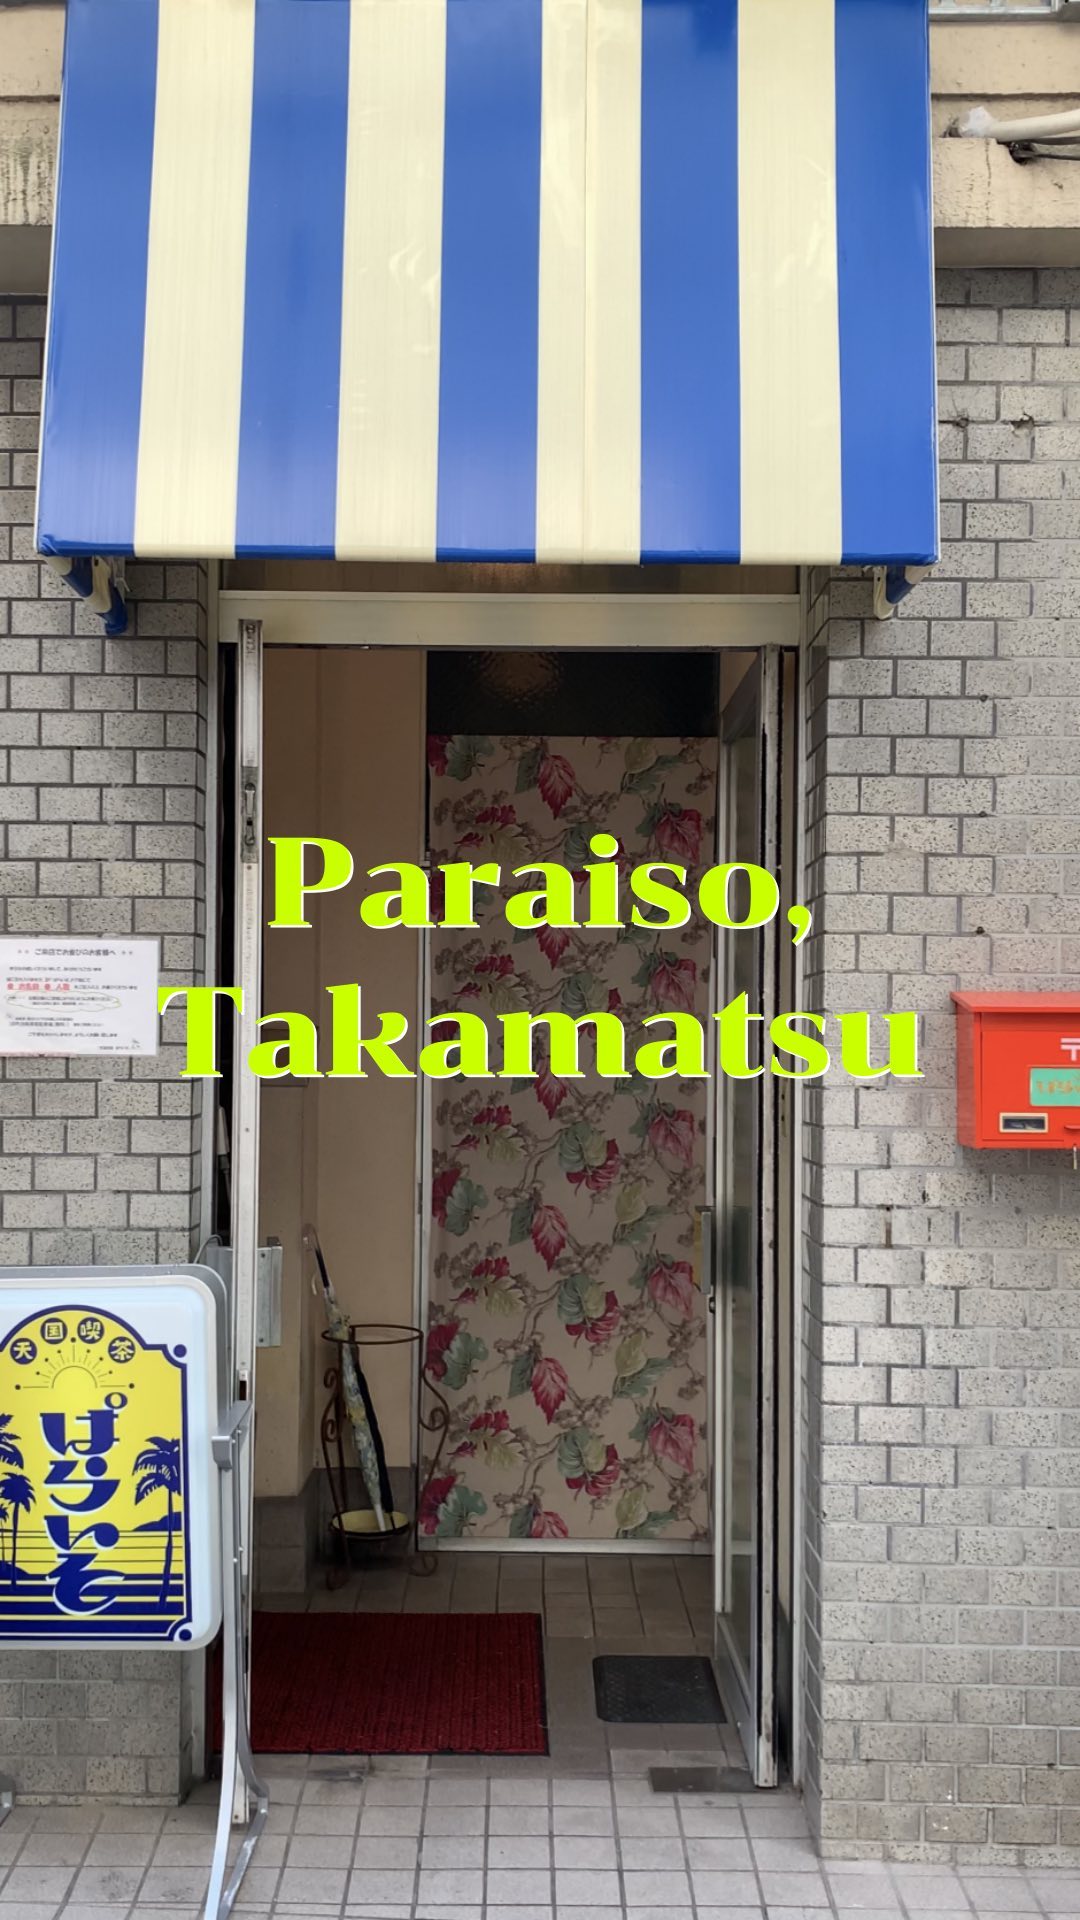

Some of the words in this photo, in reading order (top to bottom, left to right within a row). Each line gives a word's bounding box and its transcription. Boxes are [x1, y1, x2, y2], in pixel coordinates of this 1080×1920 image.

[11, 1318, 135, 1363] 天国喫茶
[39, 1391, 128, 1617] ぱらいそ
